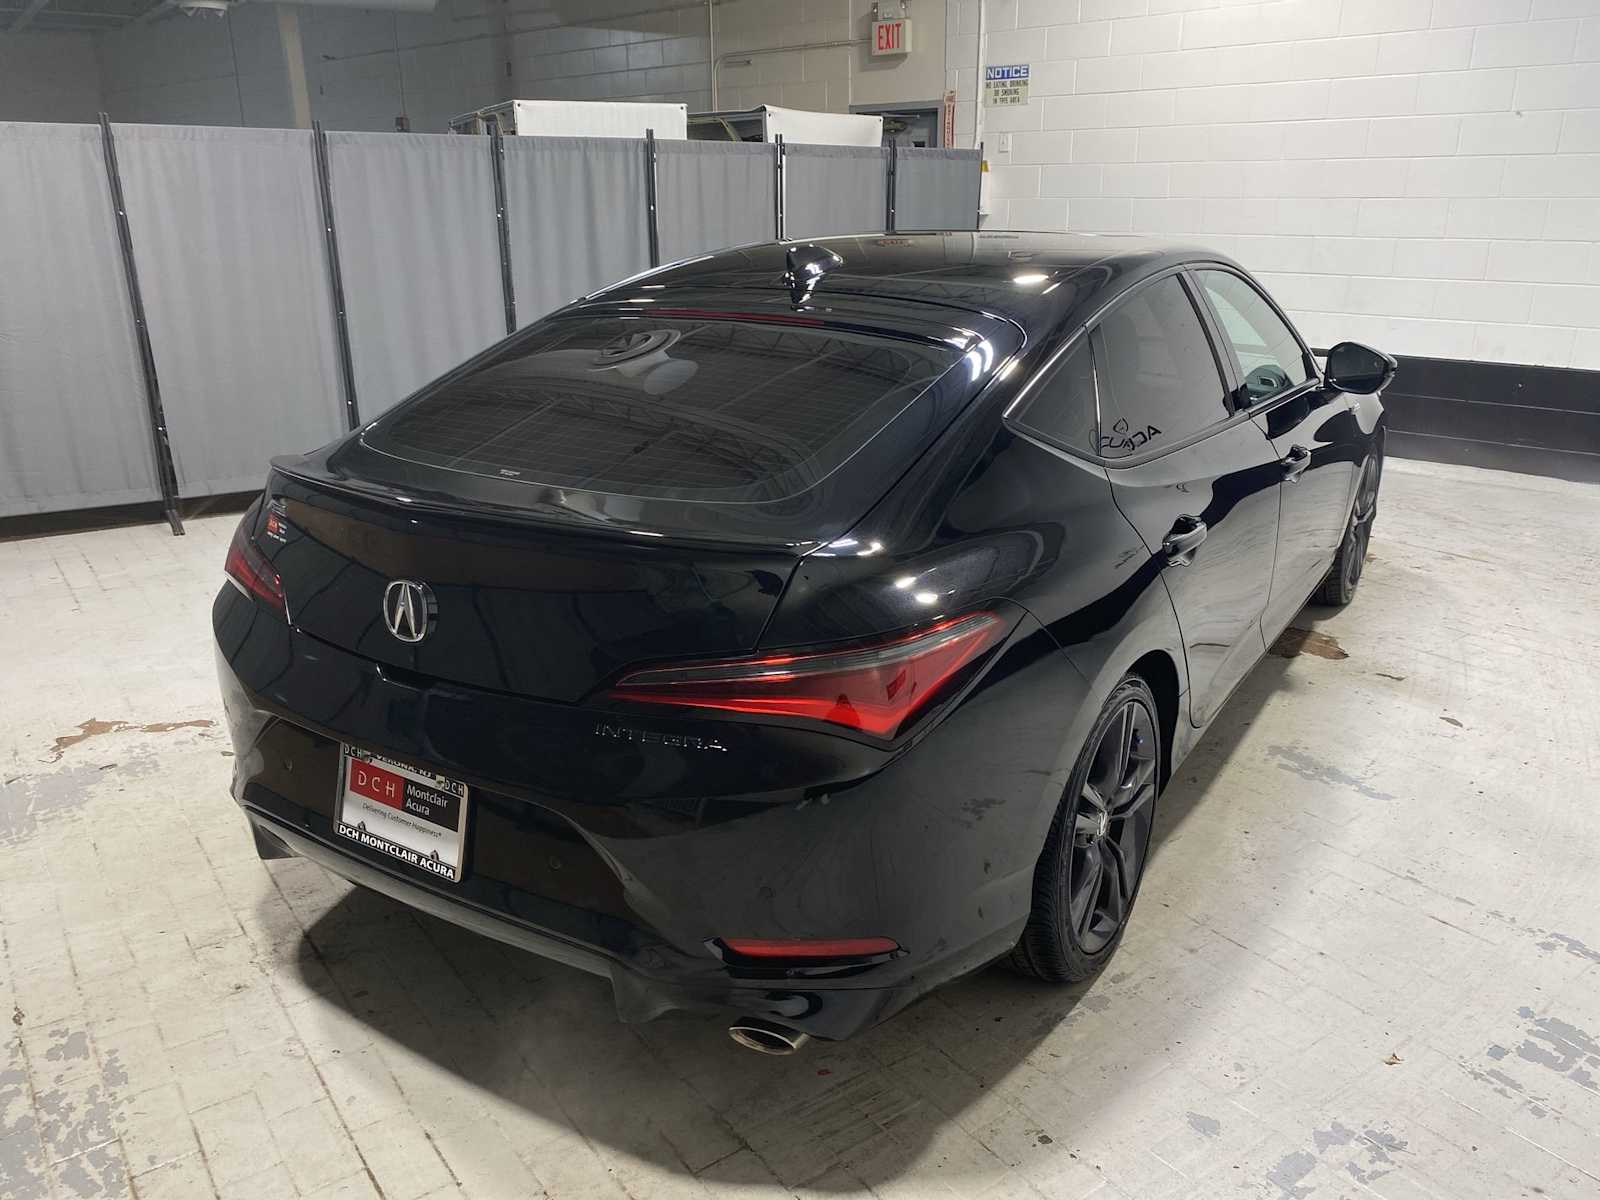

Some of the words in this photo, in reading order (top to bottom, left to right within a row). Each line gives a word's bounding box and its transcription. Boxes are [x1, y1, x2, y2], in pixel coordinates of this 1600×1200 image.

[877, 23, 902, 50] EXIT
[986, 66, 1029, 79] NOTICE
[592, 719, 728, 752] INTEGRA
[344, 744, 362, 757] DCH
[358, 771, 395, 798] DCH
[406, 784, 449, 808] Montclair
[445, 777, 465, 796] DCH
[406, 798, 430, 816] Acura
[339, 825, 359, 841] DCH
[361, 832, 418, 863] MONTCLAIR
[419, 857, 454, 879] ACURA
